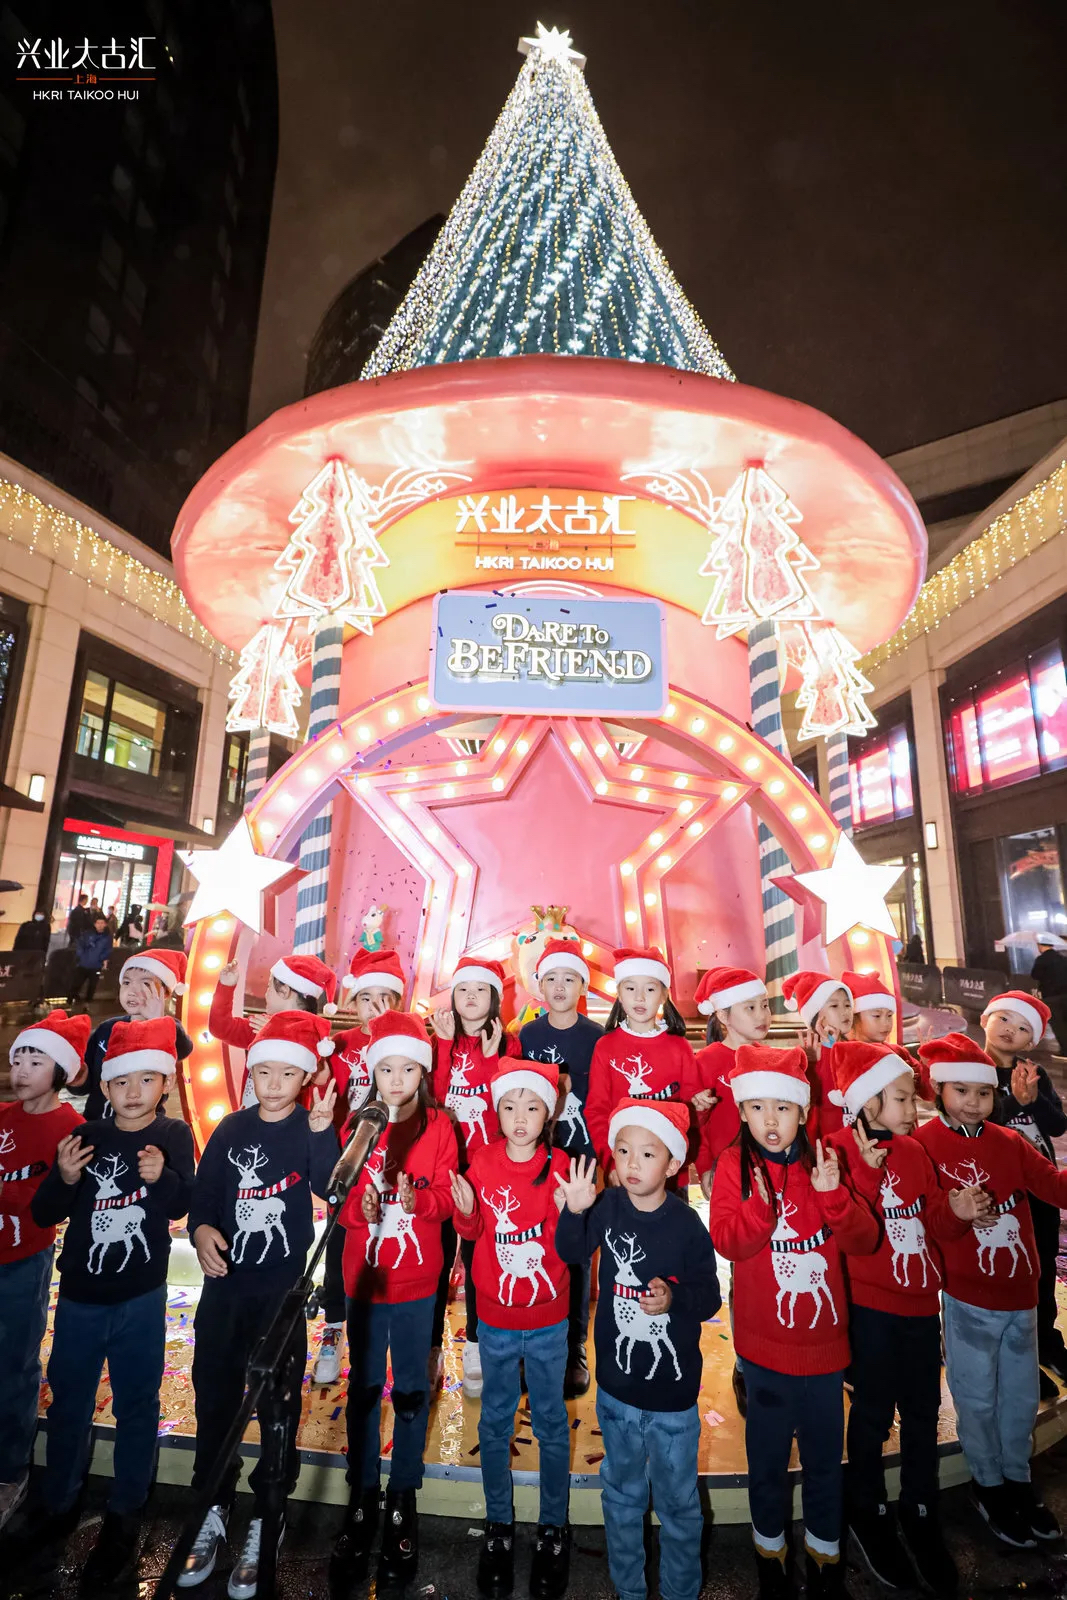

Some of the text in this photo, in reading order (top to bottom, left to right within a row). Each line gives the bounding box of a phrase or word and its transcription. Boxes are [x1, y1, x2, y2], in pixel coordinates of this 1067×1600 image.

[456, 494, 636, 535] 兴业太古汇
[475, 555, 614, 571] HKRI TAIKOO HUI
